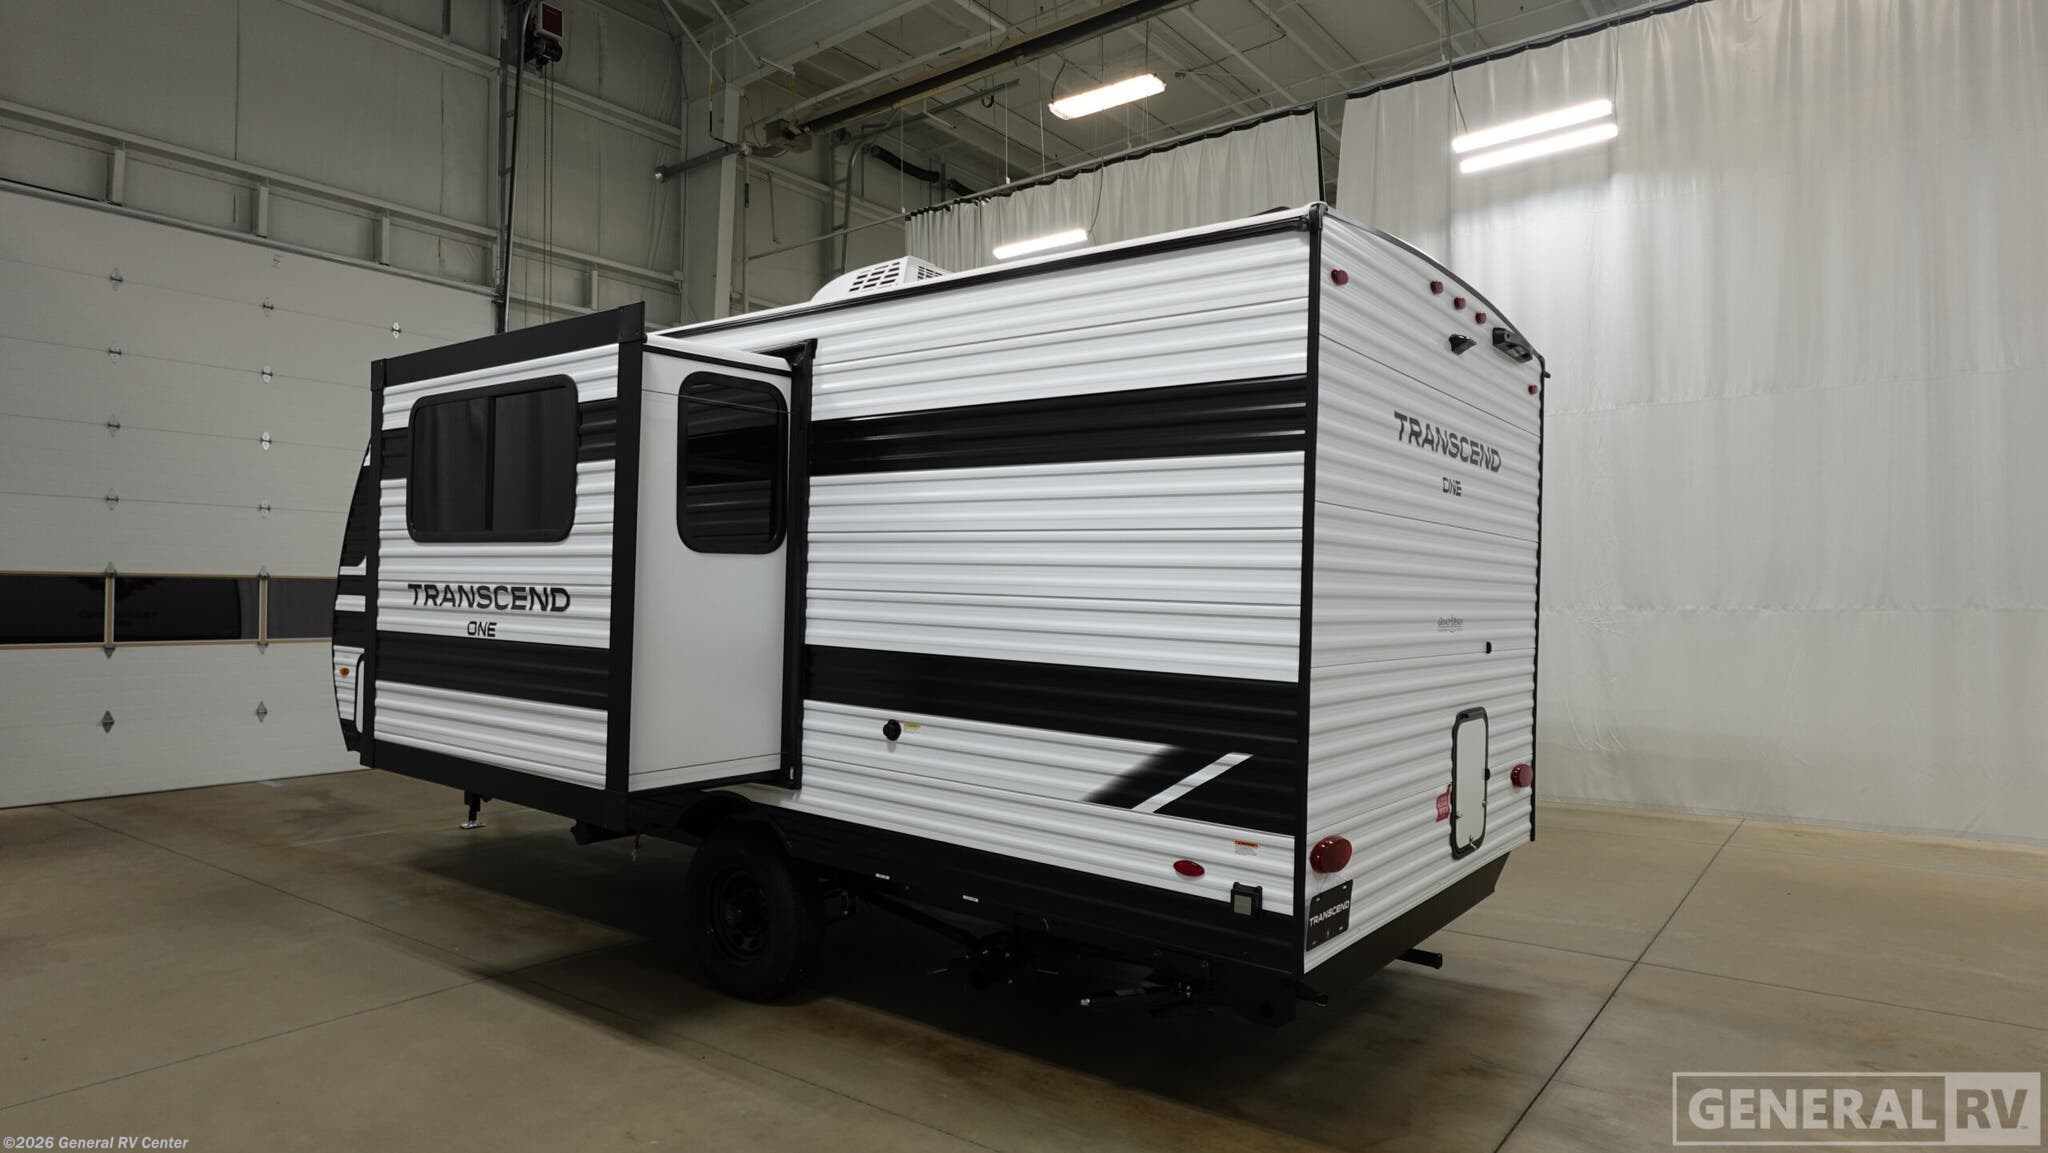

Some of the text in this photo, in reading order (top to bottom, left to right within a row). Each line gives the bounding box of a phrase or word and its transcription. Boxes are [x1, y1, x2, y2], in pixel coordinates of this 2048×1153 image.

[1394, 411, 1501, 472] TRANSCEND
[1442, 477, 1462, 496] ONE
[408, 583, 570, 612] TRANSCEND
[467, 621, 497, 637] ONE
[1309, 900, 1350, 926] TRANSCEND
